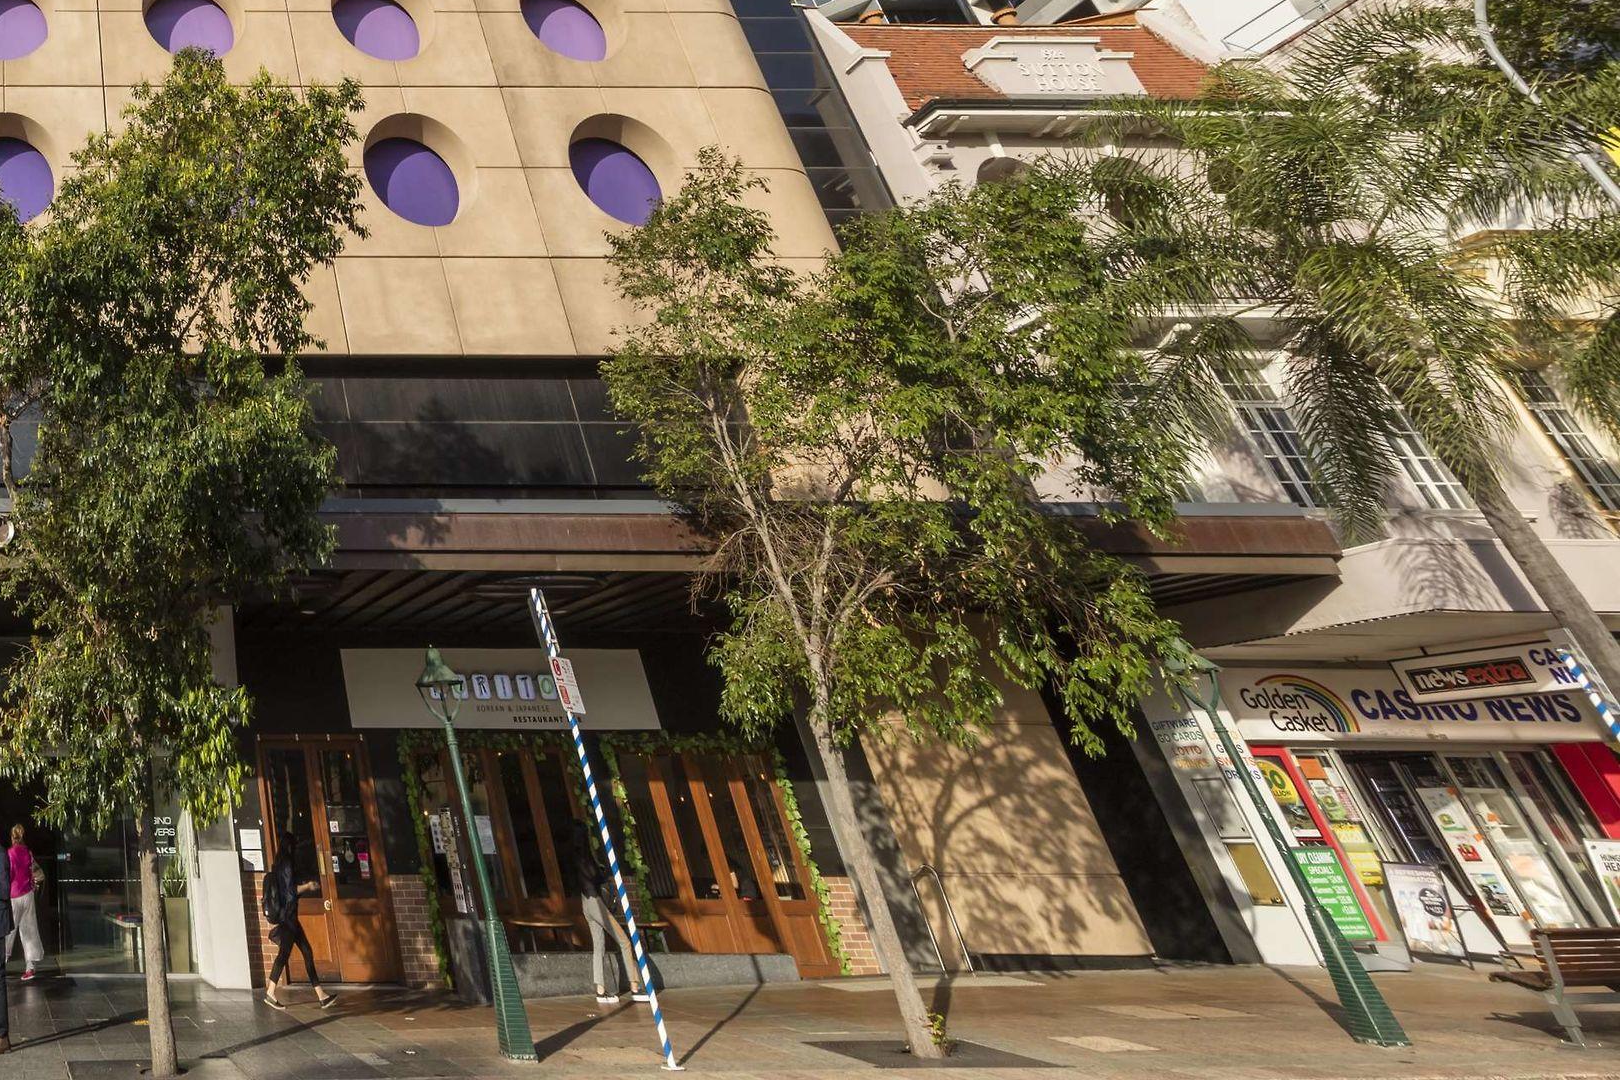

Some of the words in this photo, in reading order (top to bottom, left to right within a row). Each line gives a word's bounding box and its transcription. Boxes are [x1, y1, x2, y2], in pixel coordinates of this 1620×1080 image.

[1018, 62, 1107, 77] SUTTON
[1035, 77, 1103, 91] HOUSE
[1239, 687, 1310, 710] Golden
[476, 704, 505, 712] KOREAN
[516, 704, 549, 712] JAPANESE
[1483, 693, 1582, 723] NEWS
[1151, 718, 1197, 731] GIFTWARE
[1269, 710, 1335, 732] Casket
[1156, 733, 1170, 743] GO
[1172, 730, 1204, 741] CARDS
[1172, 744, 1203, 756] LOTTO
[1215, 744, 1244, 754] GS
[1214, 756, 1256, 767] SWTS
